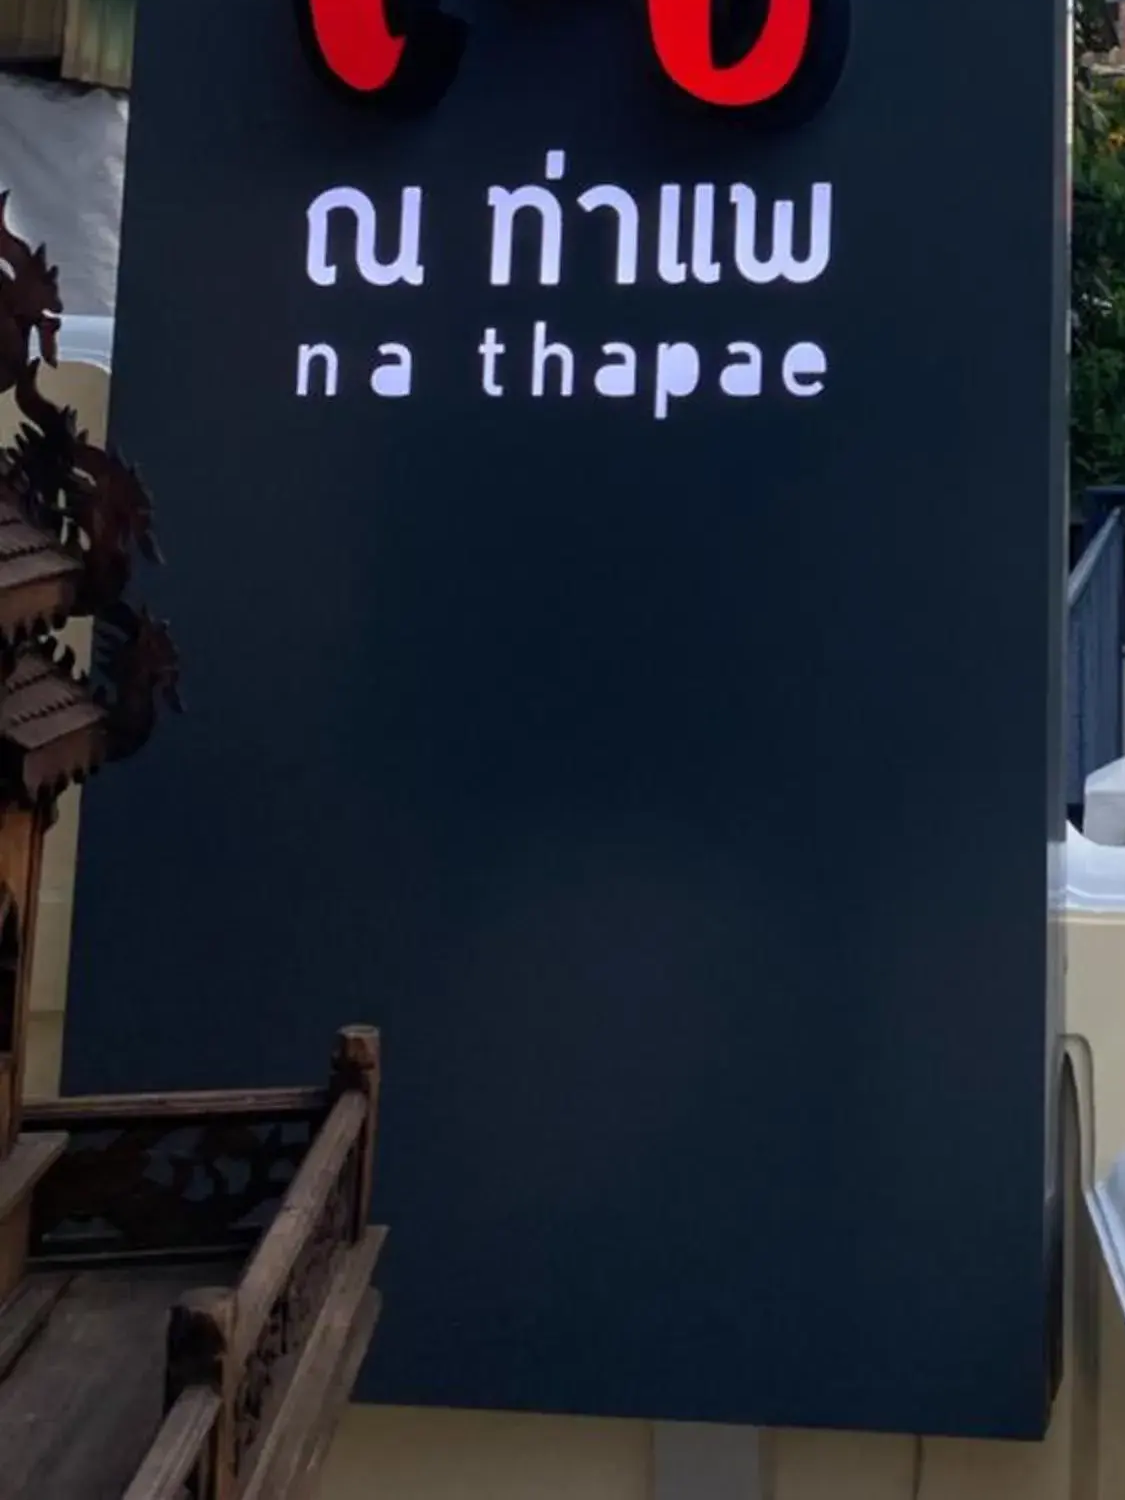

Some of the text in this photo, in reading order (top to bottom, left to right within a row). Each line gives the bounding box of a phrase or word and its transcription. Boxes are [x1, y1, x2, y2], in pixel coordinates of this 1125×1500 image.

[306, 149, 832, 287] ณ ท่าแพ
[296, 320, 827, 419] na thapae
